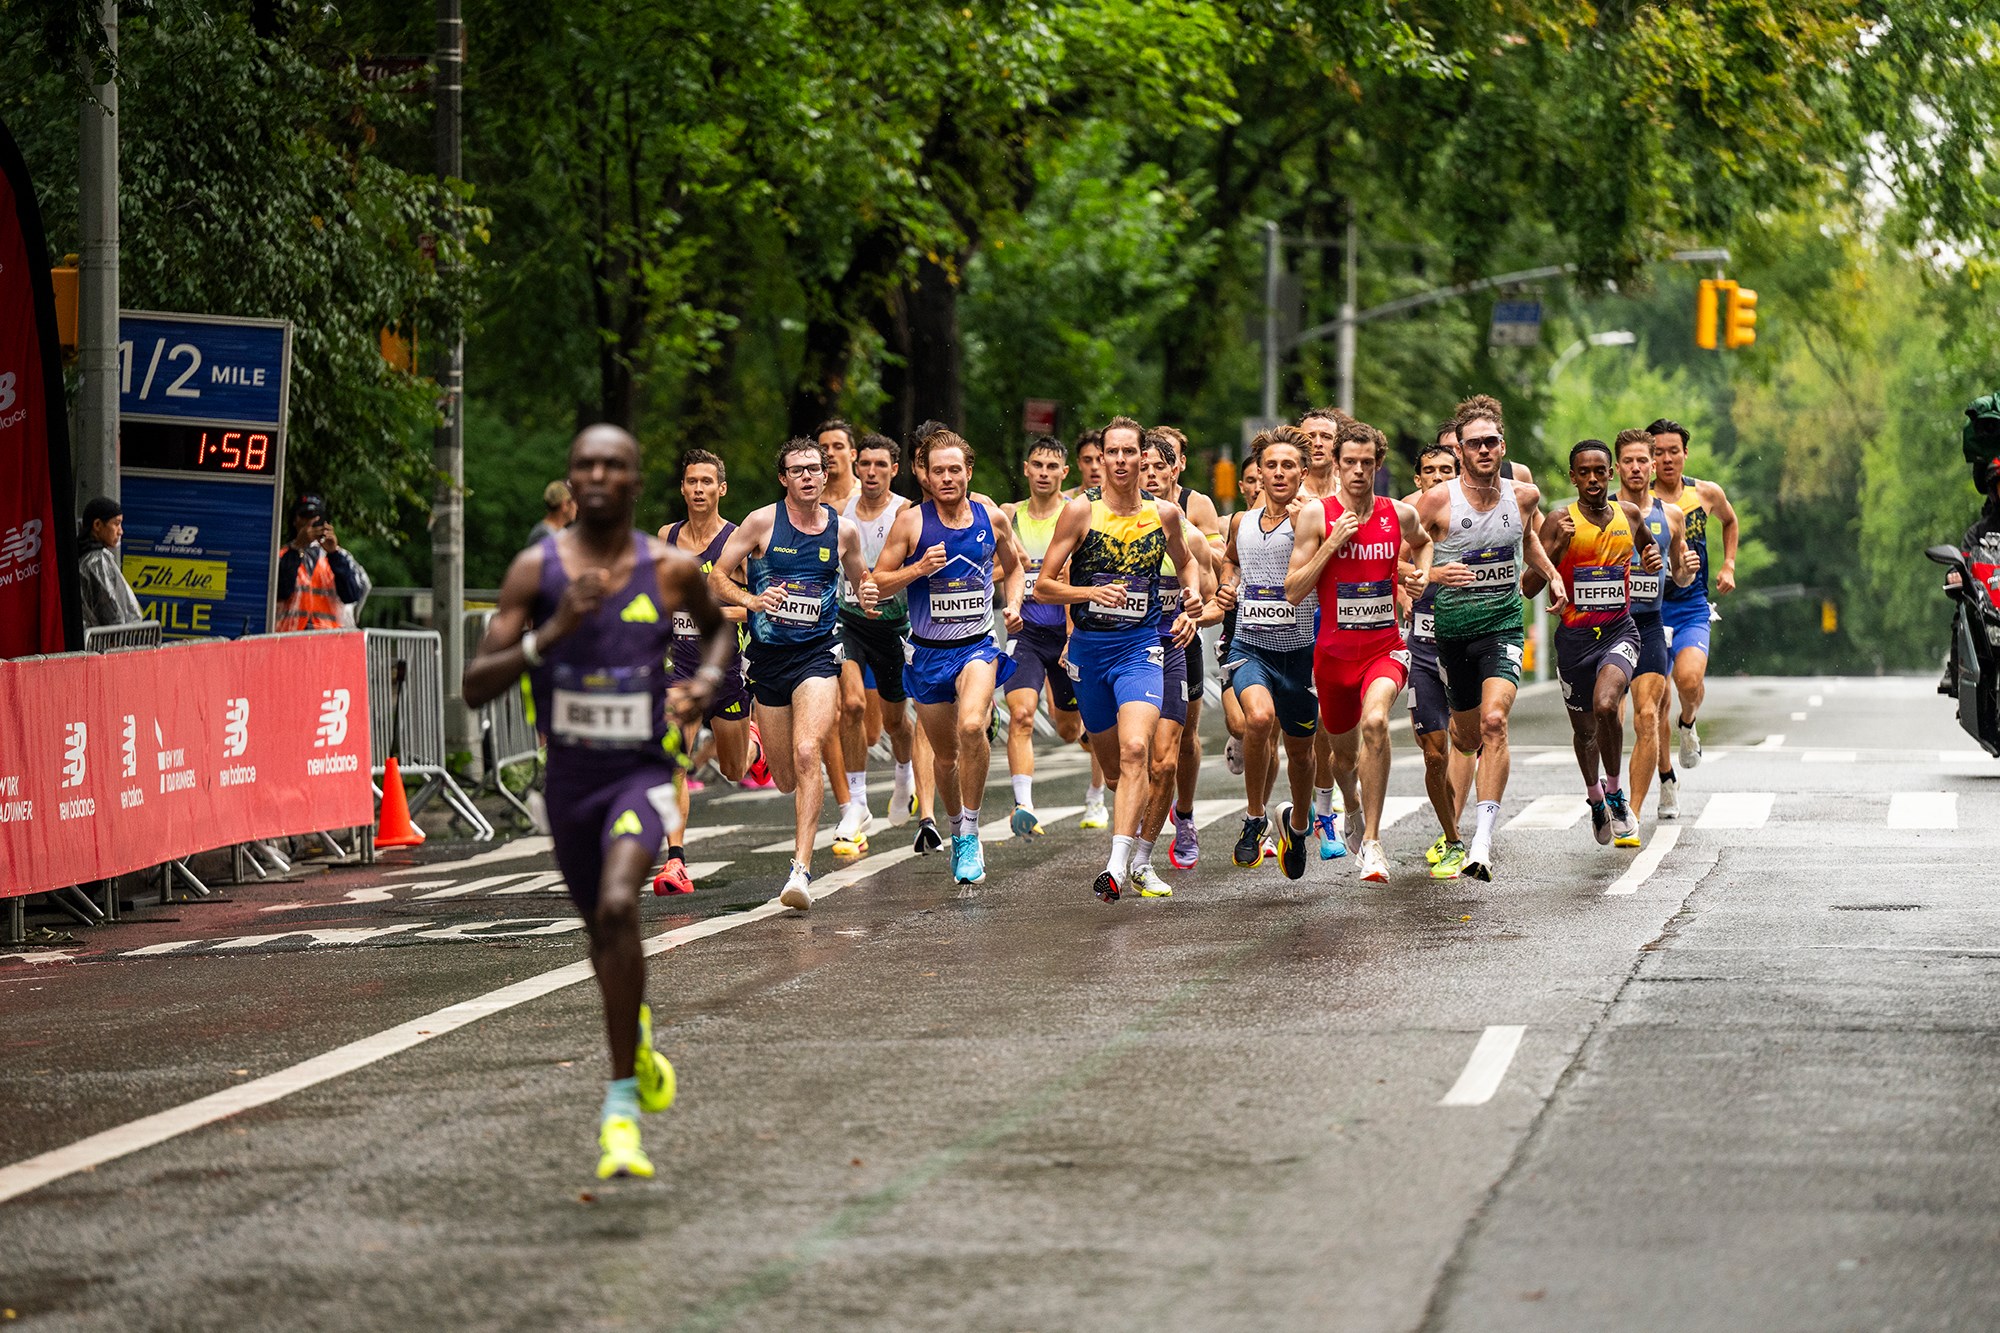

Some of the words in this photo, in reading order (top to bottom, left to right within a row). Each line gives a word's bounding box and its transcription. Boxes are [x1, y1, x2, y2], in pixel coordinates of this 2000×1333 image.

[119, 338, 202, 400] 1/2
[211, 365, 266, 387] MILE
[171, 545, 203, 556] balance
[773, 546, 798, 555] BROOKS
[1337, 541, 1395, 560] CYMRU
[132, 564, 173, 589] 5th
[1474, 565, 1514, 582] OARE
[1575, 587, 1625, 599] TEFFRA
[778, 600, 821, 616] ARTIN
[931, 597, 985, 611] HUNTER
[1243, 606, 1295, 618] LANGON
[1338, 602, 1394, 617] HEYWARD
[673, 617, 696, 629] PRA
[307, 757, 325, 776] new
[325, 752, 359, 775] balance
[220, 769, 230, 788] new
[230, 763, 257, 786] balance
[69, 795, 96, 819] balance
